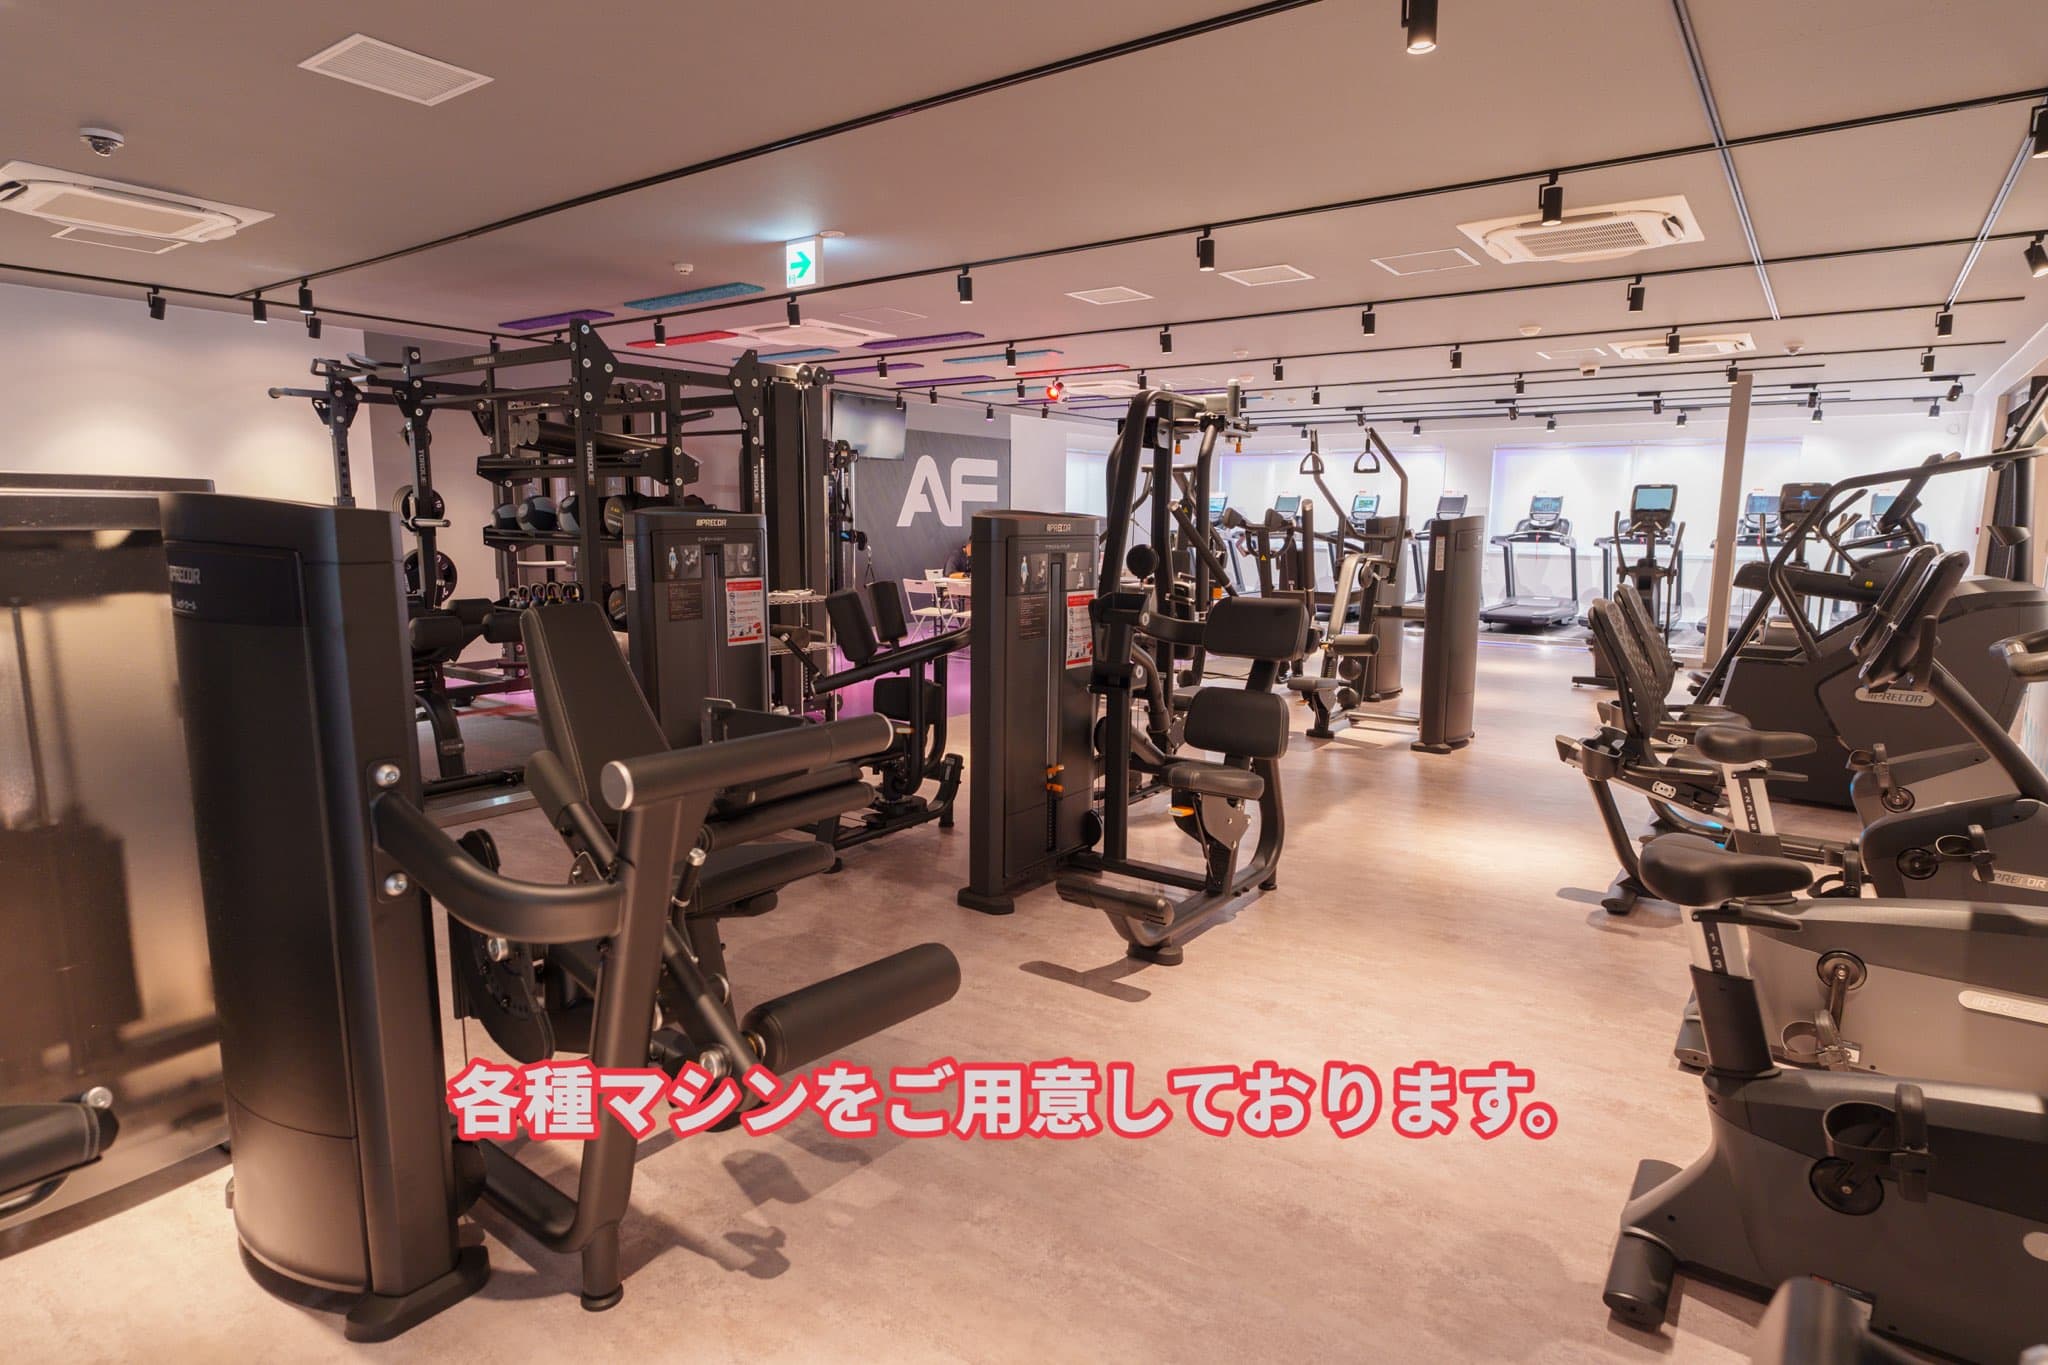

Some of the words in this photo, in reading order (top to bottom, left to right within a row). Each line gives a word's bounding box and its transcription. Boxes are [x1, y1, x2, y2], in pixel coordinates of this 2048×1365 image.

[896, 455, 998, 527] AF
[697, 519, 727, 527] PRECOR
[1709, 932, 1716, 942] 1
[1711, 945, 1721, 956] 2
[1714, 959, 1723, 969] 3
